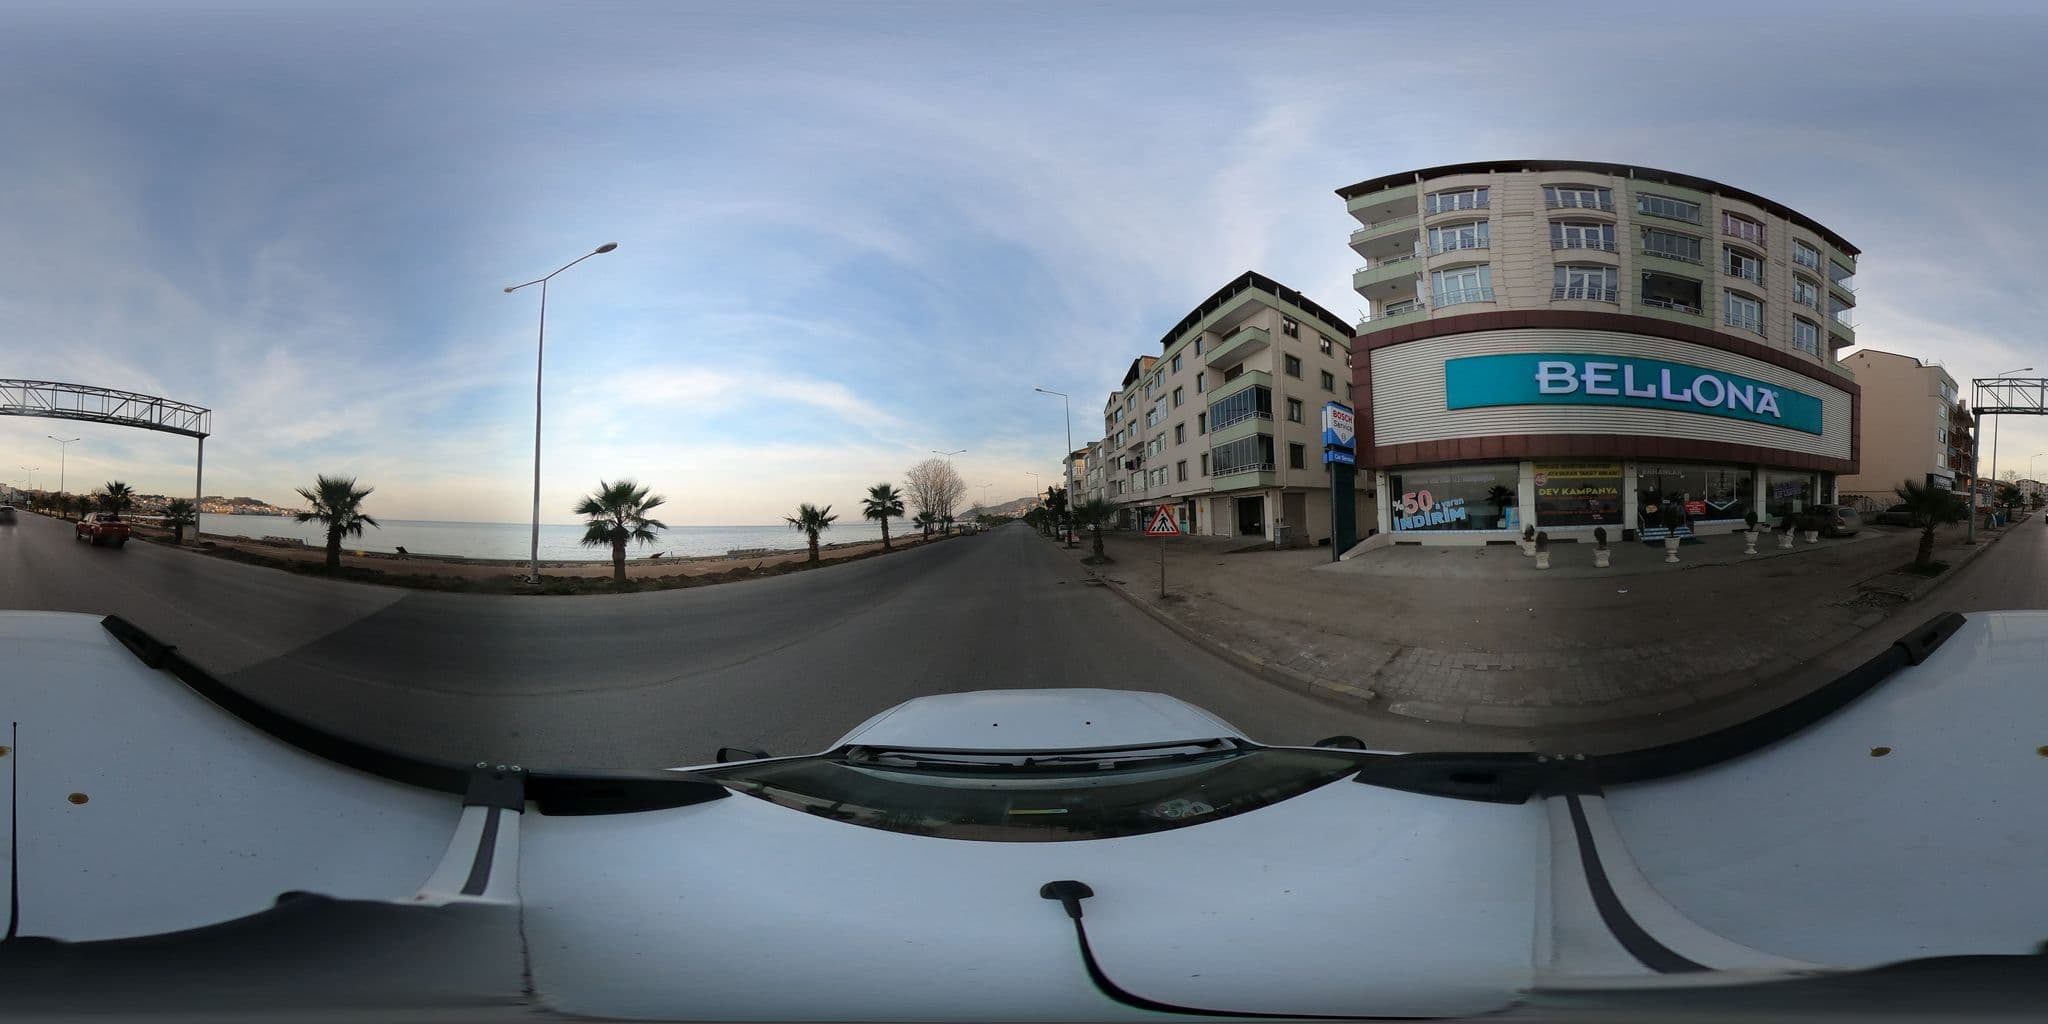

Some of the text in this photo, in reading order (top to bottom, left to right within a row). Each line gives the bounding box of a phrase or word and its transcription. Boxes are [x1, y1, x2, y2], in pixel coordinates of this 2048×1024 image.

[1535, 361, 1781, 418] BELLONA
[1332, 410, 1353, 424] BOSCH
[1333, 420, 1353, 432] Service
[1539, 487, 1618, 496] DEV KAMPANYA
